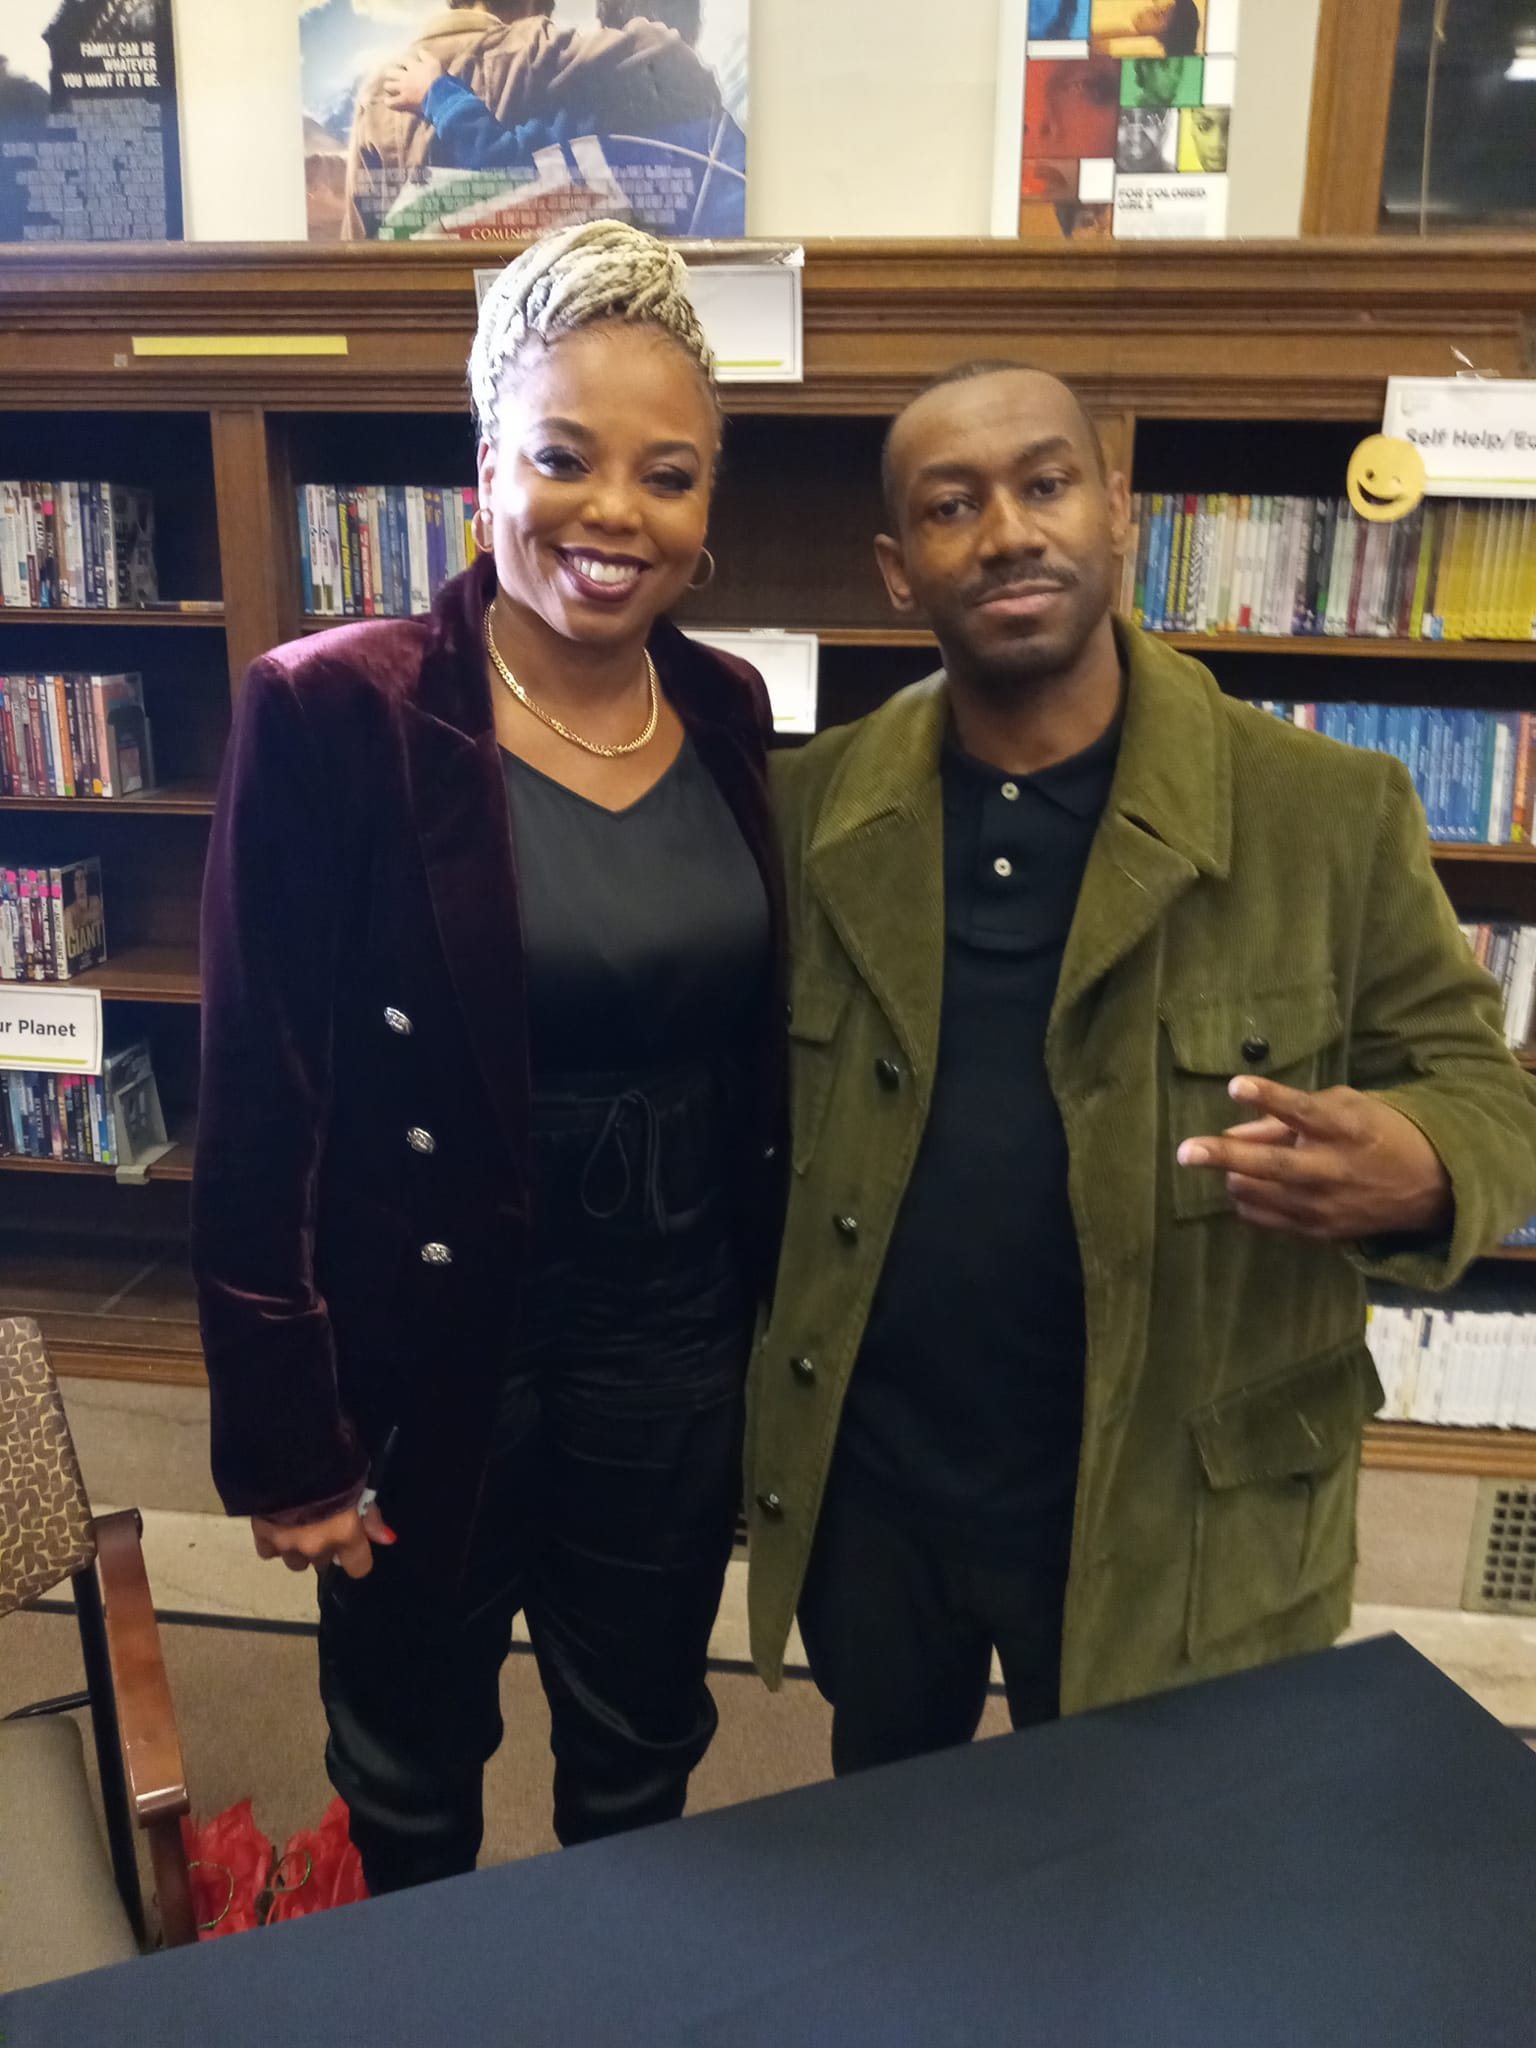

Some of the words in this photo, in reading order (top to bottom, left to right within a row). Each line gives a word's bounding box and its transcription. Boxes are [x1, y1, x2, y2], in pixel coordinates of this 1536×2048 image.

[80, 41, 116, 57] FAMILY
[117, 41, 140, 57] CAN
[141, 41, 156, 57] BE
[103, 57, 157, 72] WHATEVER
[62, 72, 83, 88] YOU
[84, 72, 113, 88] WANT
[115, 72, 125, 88] IT
[127, 72, 142, 88] TO
[471, 227, 530, 240] COMING
[1406, 428, 1447, 447] Self
[67, 921, 103, 960] GIANT
[18, 1019, 77, 1038] Planet
